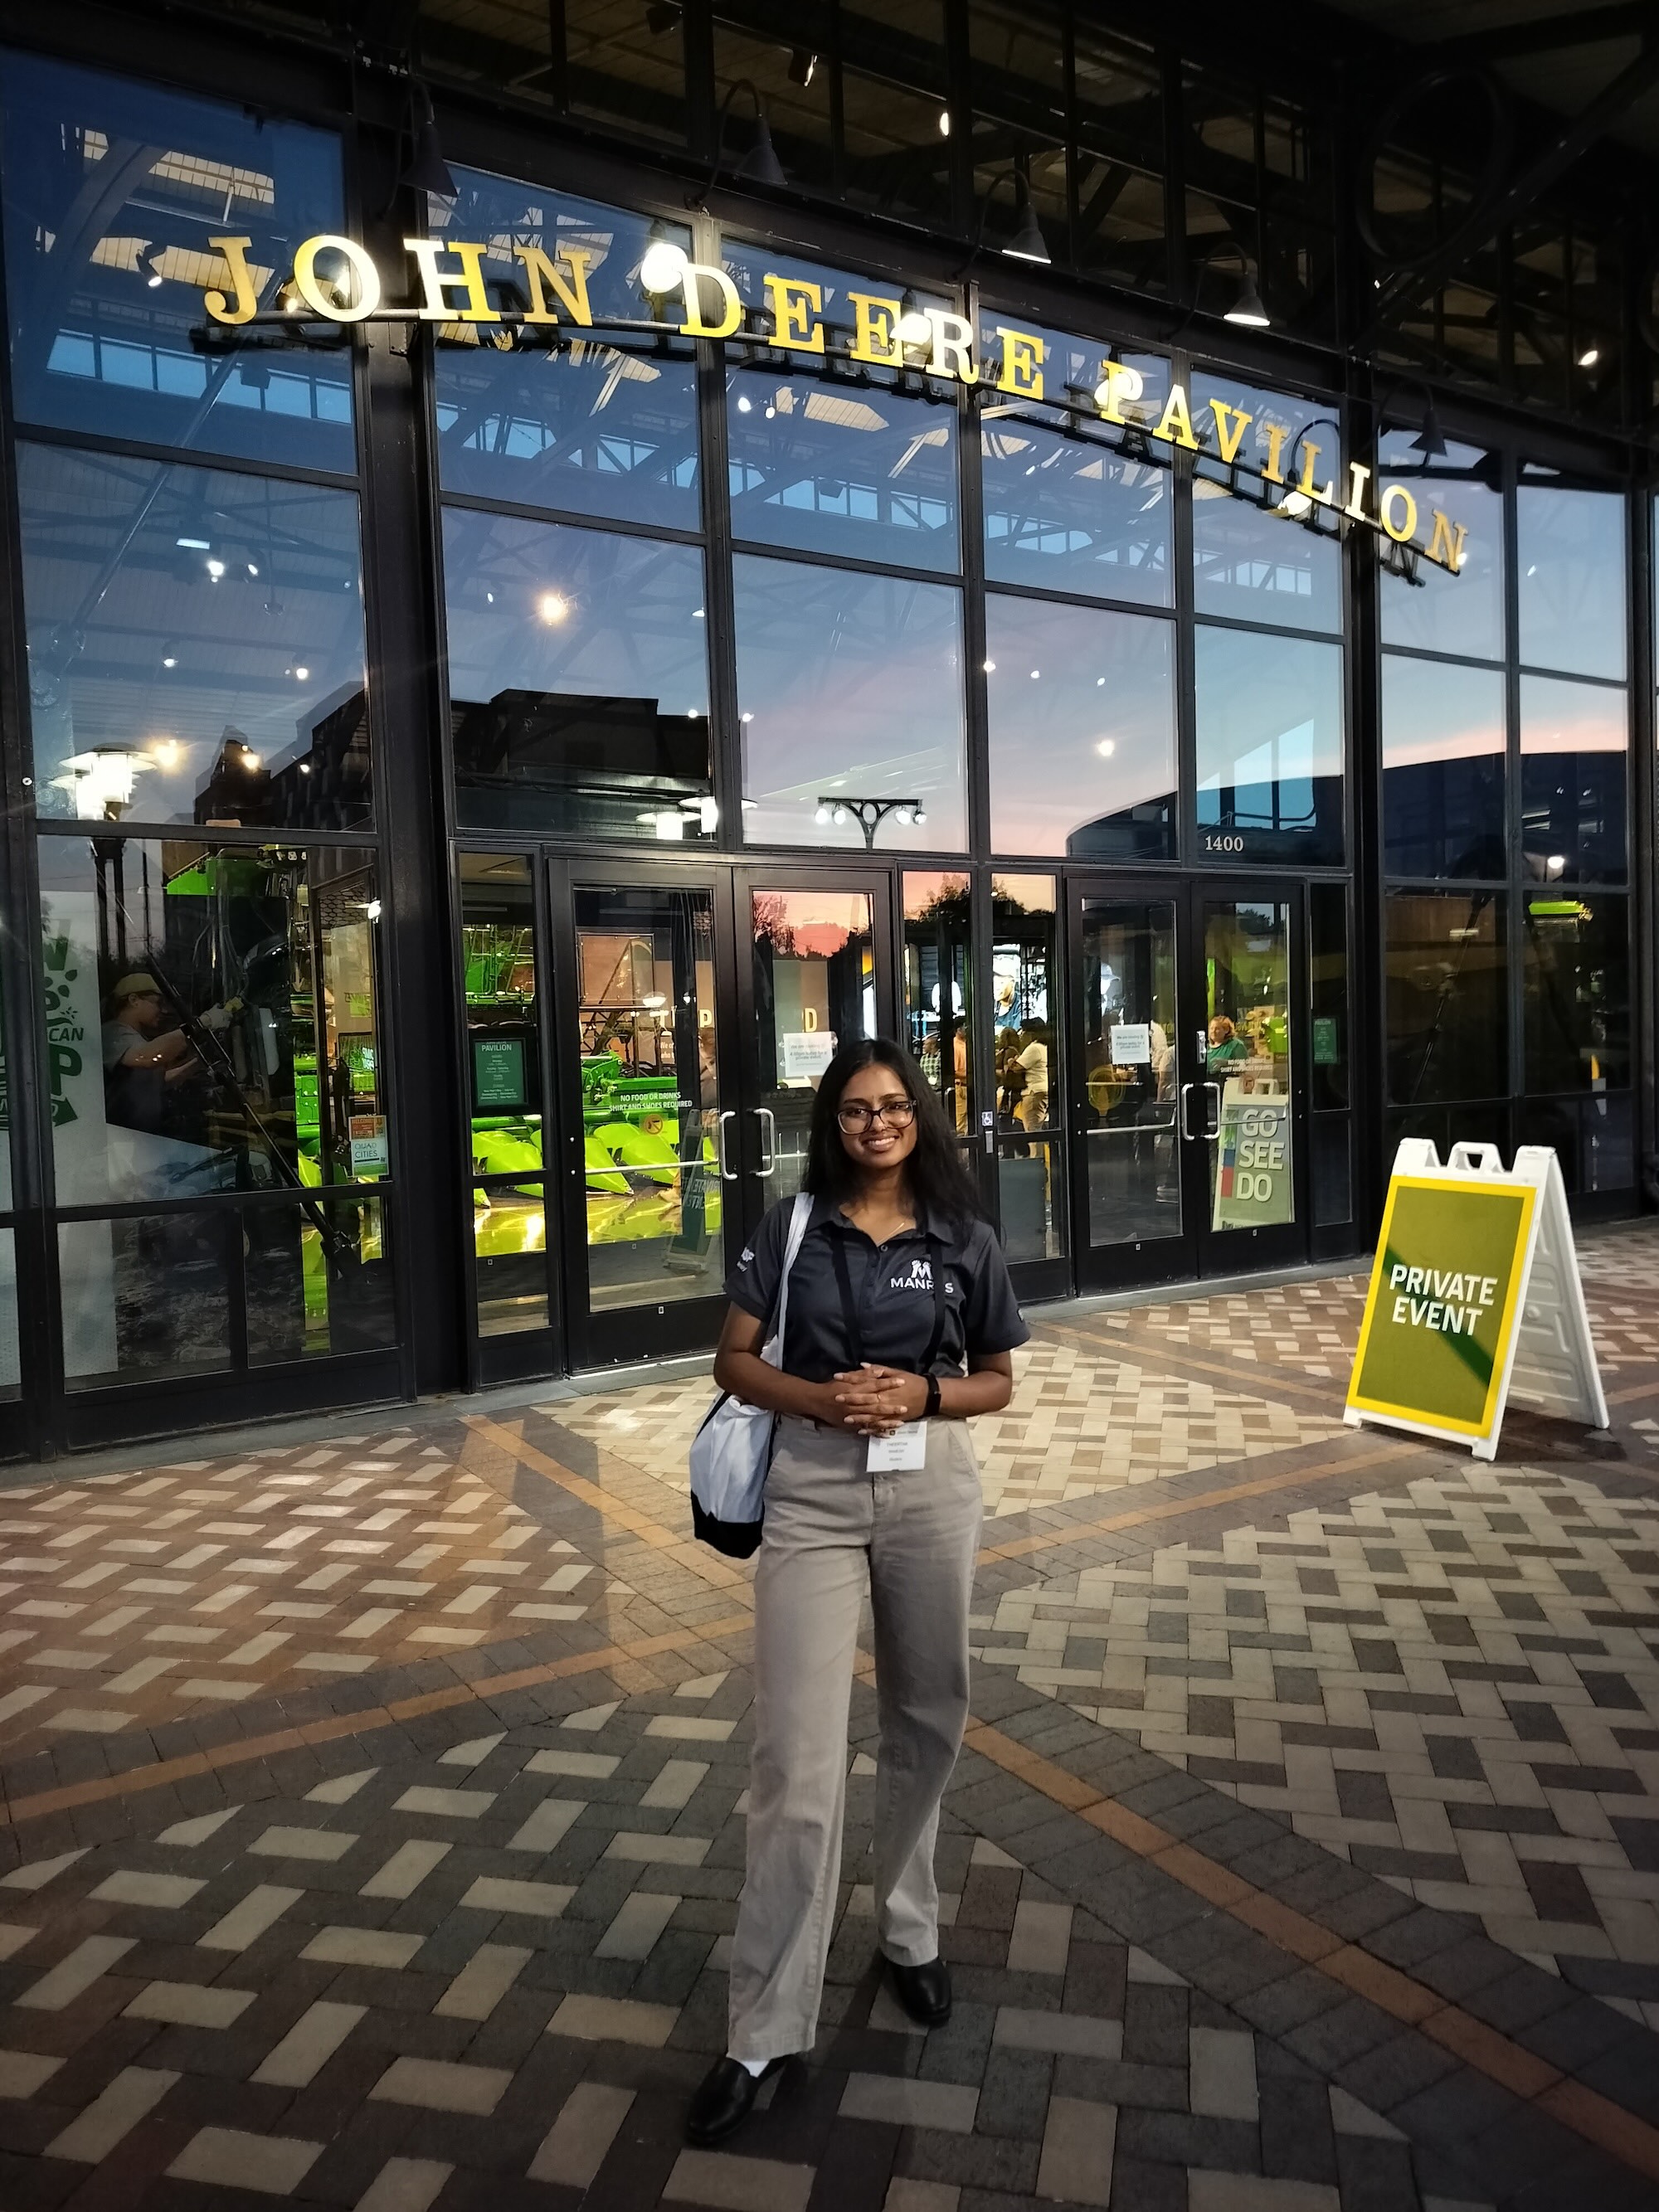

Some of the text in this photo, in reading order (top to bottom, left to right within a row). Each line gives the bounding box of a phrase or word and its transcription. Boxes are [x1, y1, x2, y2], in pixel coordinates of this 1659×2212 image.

[205, 234, 1470, 575] JOHN DEERE PAVILION
[1205, 835, 1243, 852] 1400
[642, 1101, 663, 1110] SHOES
[663, 1100, 693, 1110] REQUIRED
[1242, 1109, 1278, 1138] GO
[355, 1150, 378, 1159] CITIES
[1239, 1140, 1285, 1170] SEE
[1237, 1172, 1272, 1202] DO
[890, 1277, 954, 1294] MANRS
[1389, 1264, 1498, 1305] PRIVATE
[1392, 1296, 1483, 1336] EVENT
